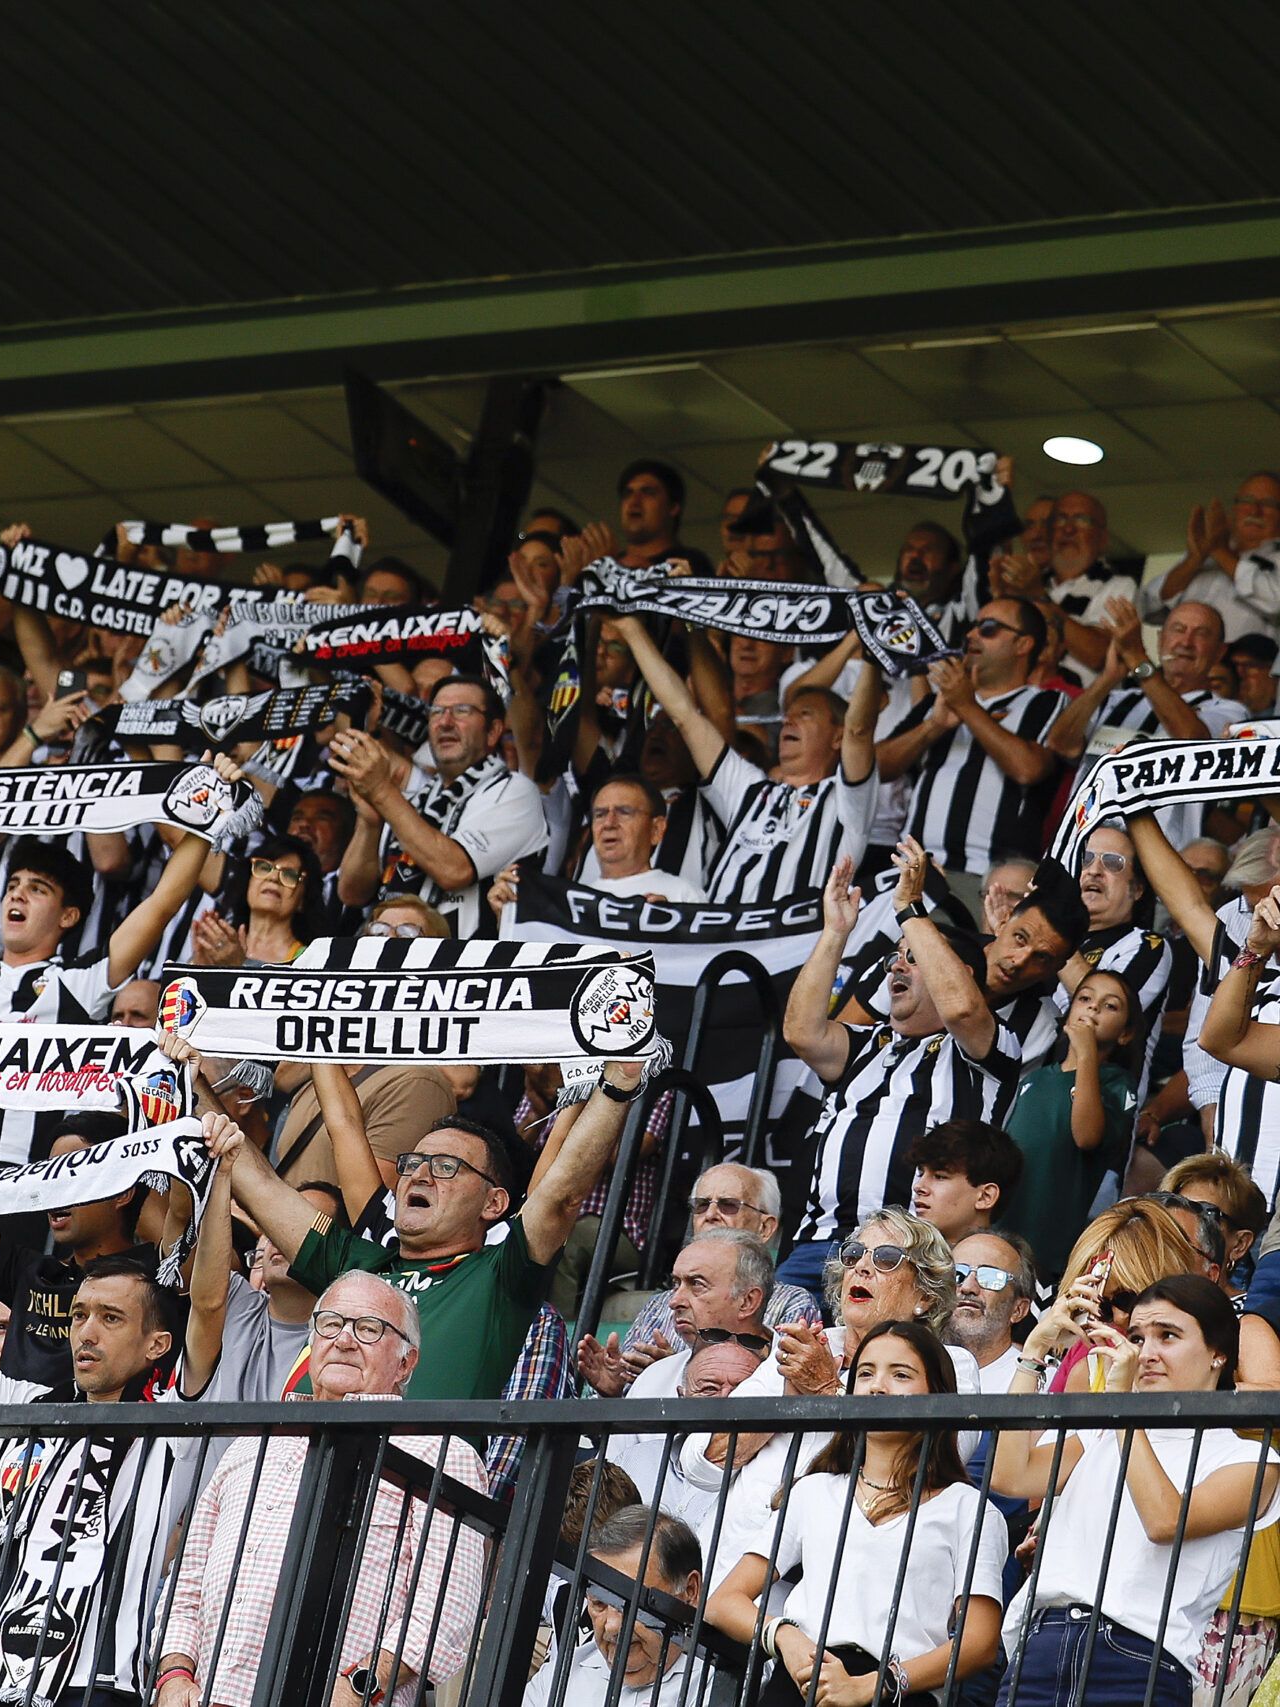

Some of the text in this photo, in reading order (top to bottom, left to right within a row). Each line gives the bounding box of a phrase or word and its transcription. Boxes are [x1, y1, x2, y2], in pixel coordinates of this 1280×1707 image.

[11, 543, 50, 578] MI
[90, 563, 161, 605] LATE
[158, 577, 221, 615] POR
[54, 593, 155, 636] C.D. CASTEL
[1112, 755, 1186, 795] PAM
[1189, 745, 1266, 782] PAM
[229, 975, 534, 1011] RESISTÈNCIA
[590, 979, 620, 1014] ORELLUT
[275, 1016, 481, 1055] ORELLUT
[626, 1019, 648, 1041] #RO
[6, 1070, 31, 1091] en
[566, 1062, 606, 1079] C.D. CAS
